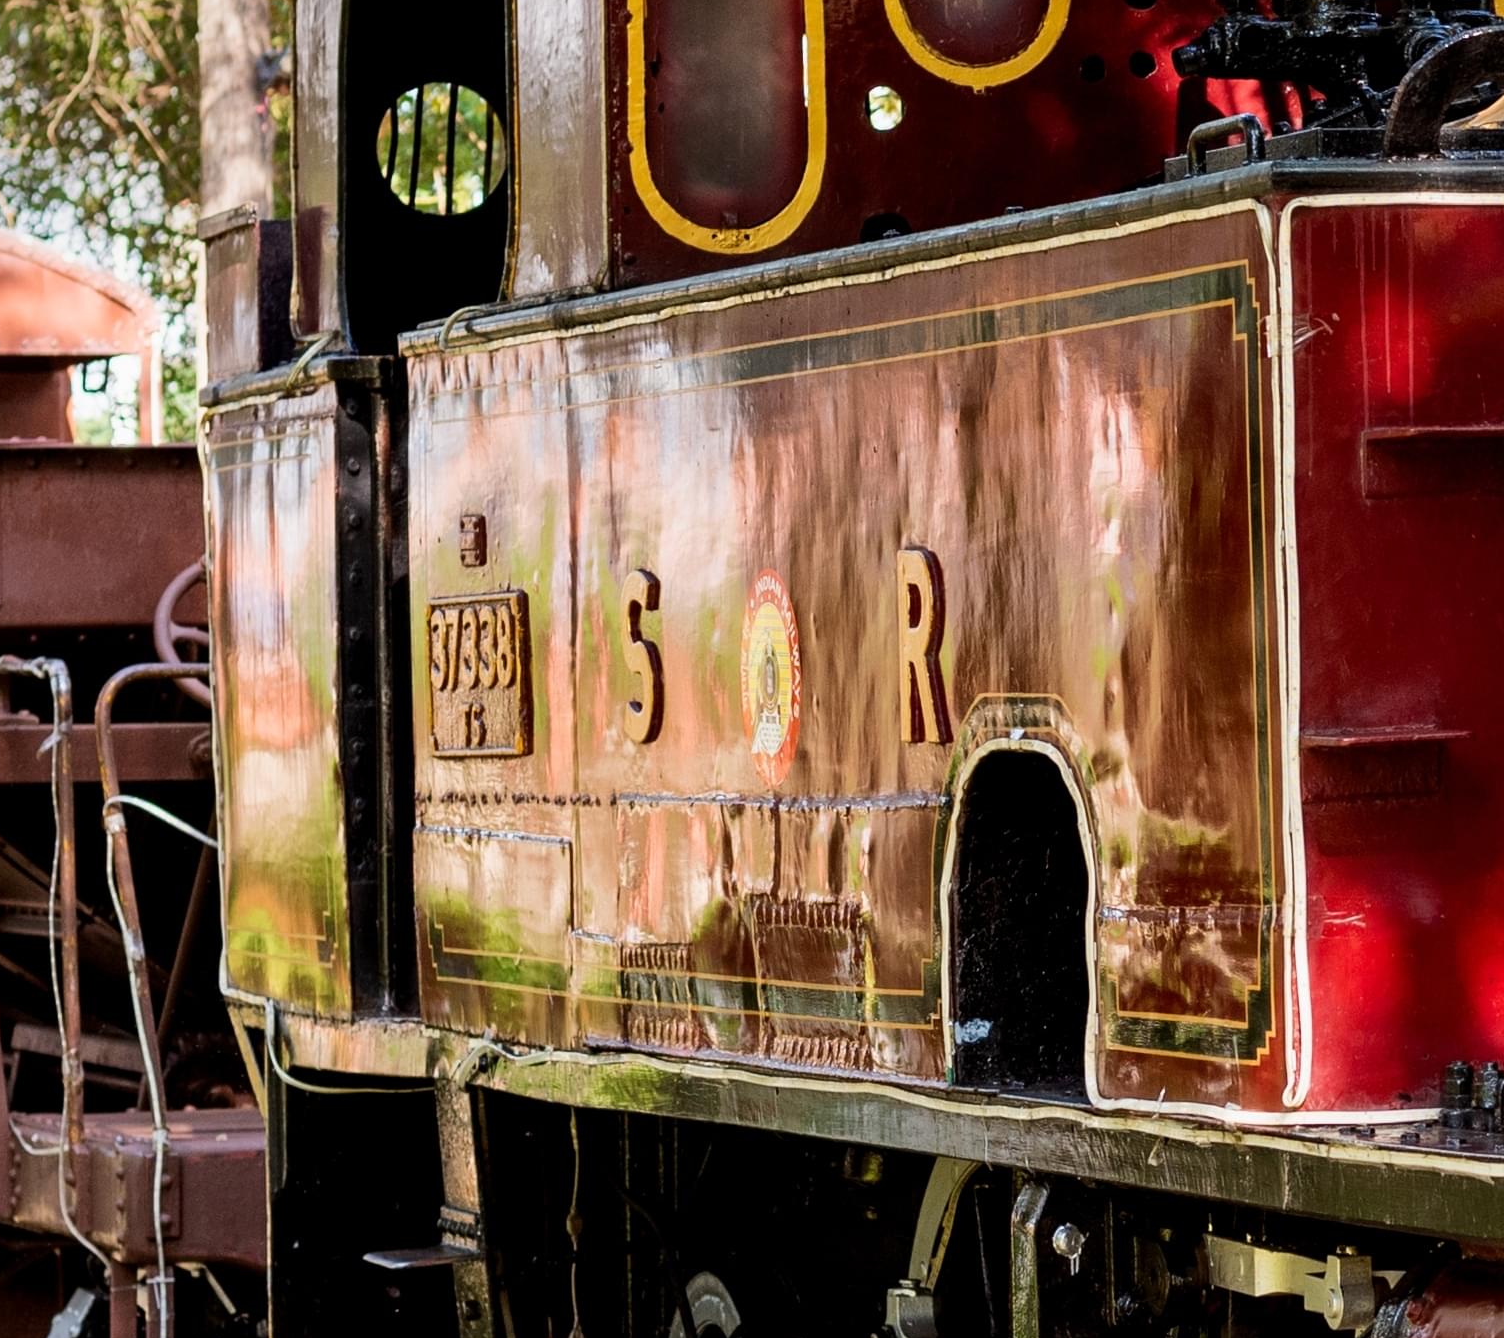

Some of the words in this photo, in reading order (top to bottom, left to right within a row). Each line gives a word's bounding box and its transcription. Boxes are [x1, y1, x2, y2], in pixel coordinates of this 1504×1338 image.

[430, 603, 516, 692] 37338
[620, 569, 664, 745] S
[896, 546, 954, 744] R
[754, 574, 783, 599] INDIAN
[780, 595, 801, 719] RAILWAYS
